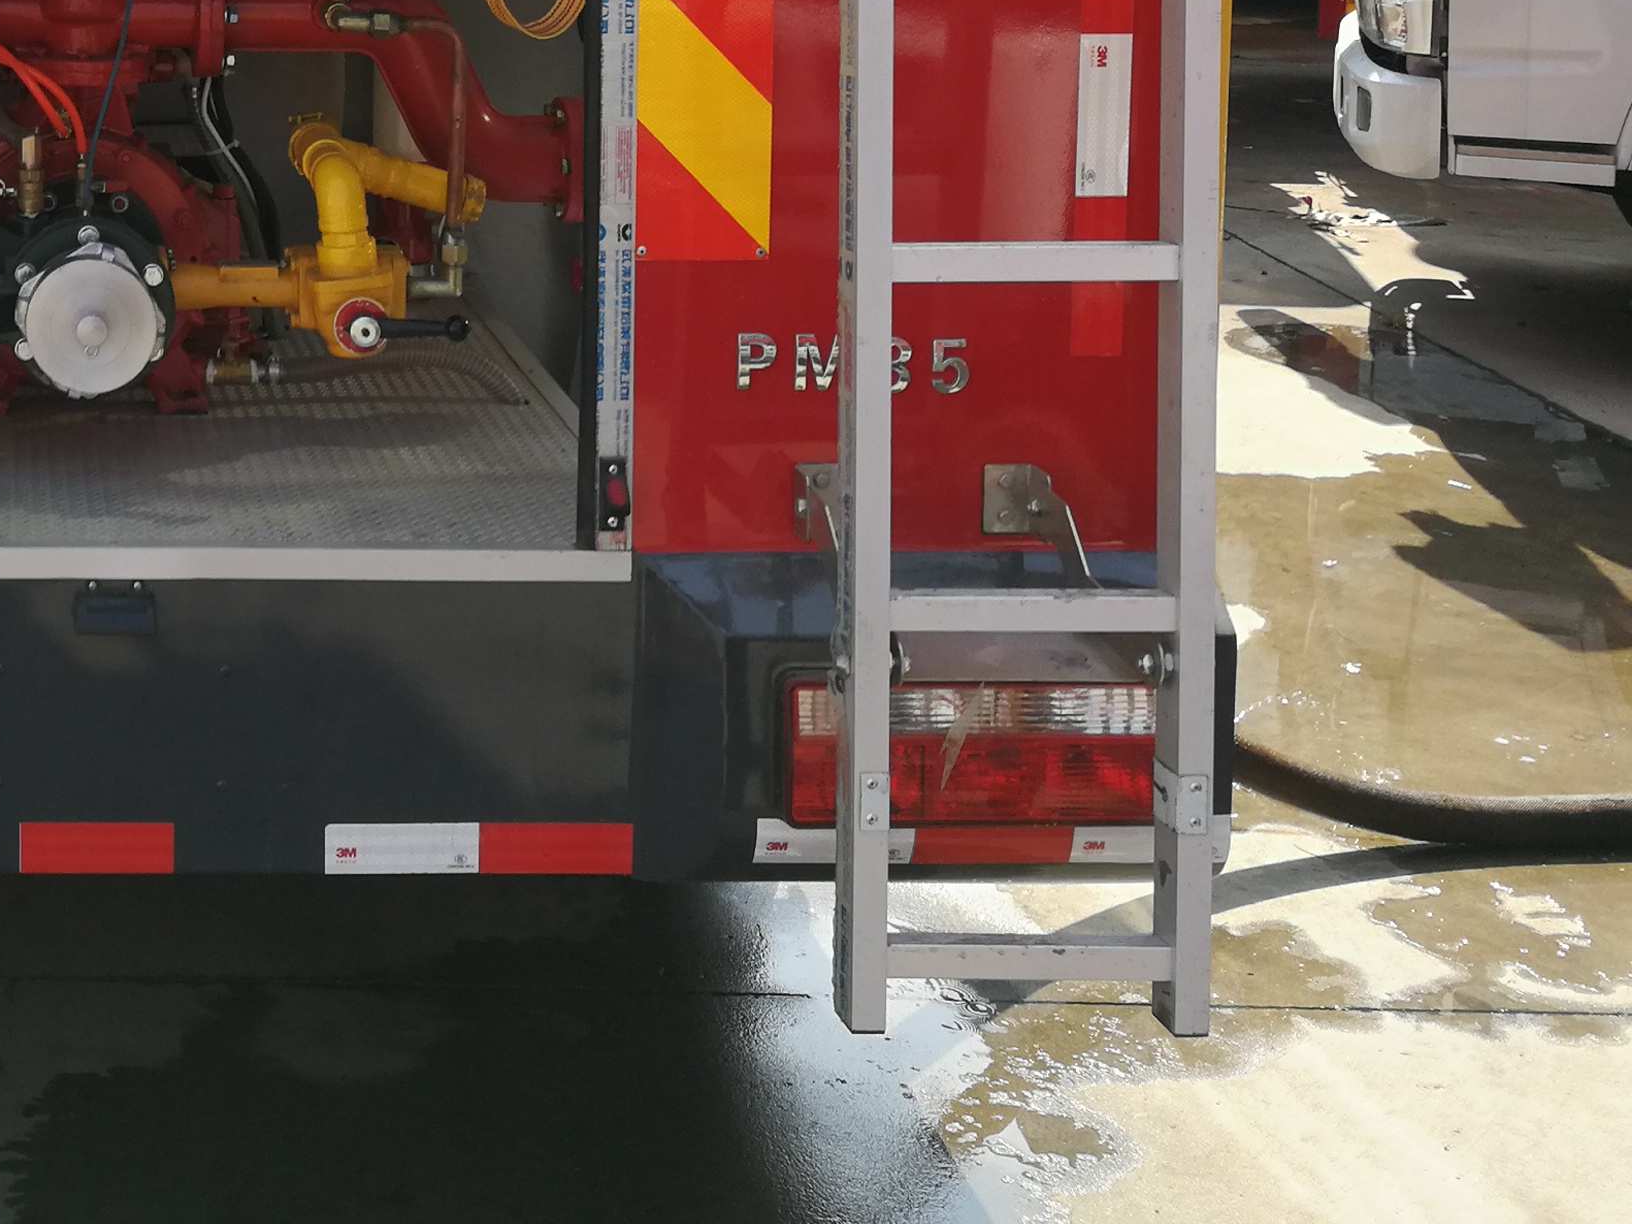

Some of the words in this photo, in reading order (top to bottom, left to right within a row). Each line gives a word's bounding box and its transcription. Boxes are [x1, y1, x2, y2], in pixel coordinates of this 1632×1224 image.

[1096, 45, 1108, 68] 3M
[766, 841, 789, 852] 3M
[1082, 840, 1106, 852] 3M
[336, 847, 357, 858] 3M
